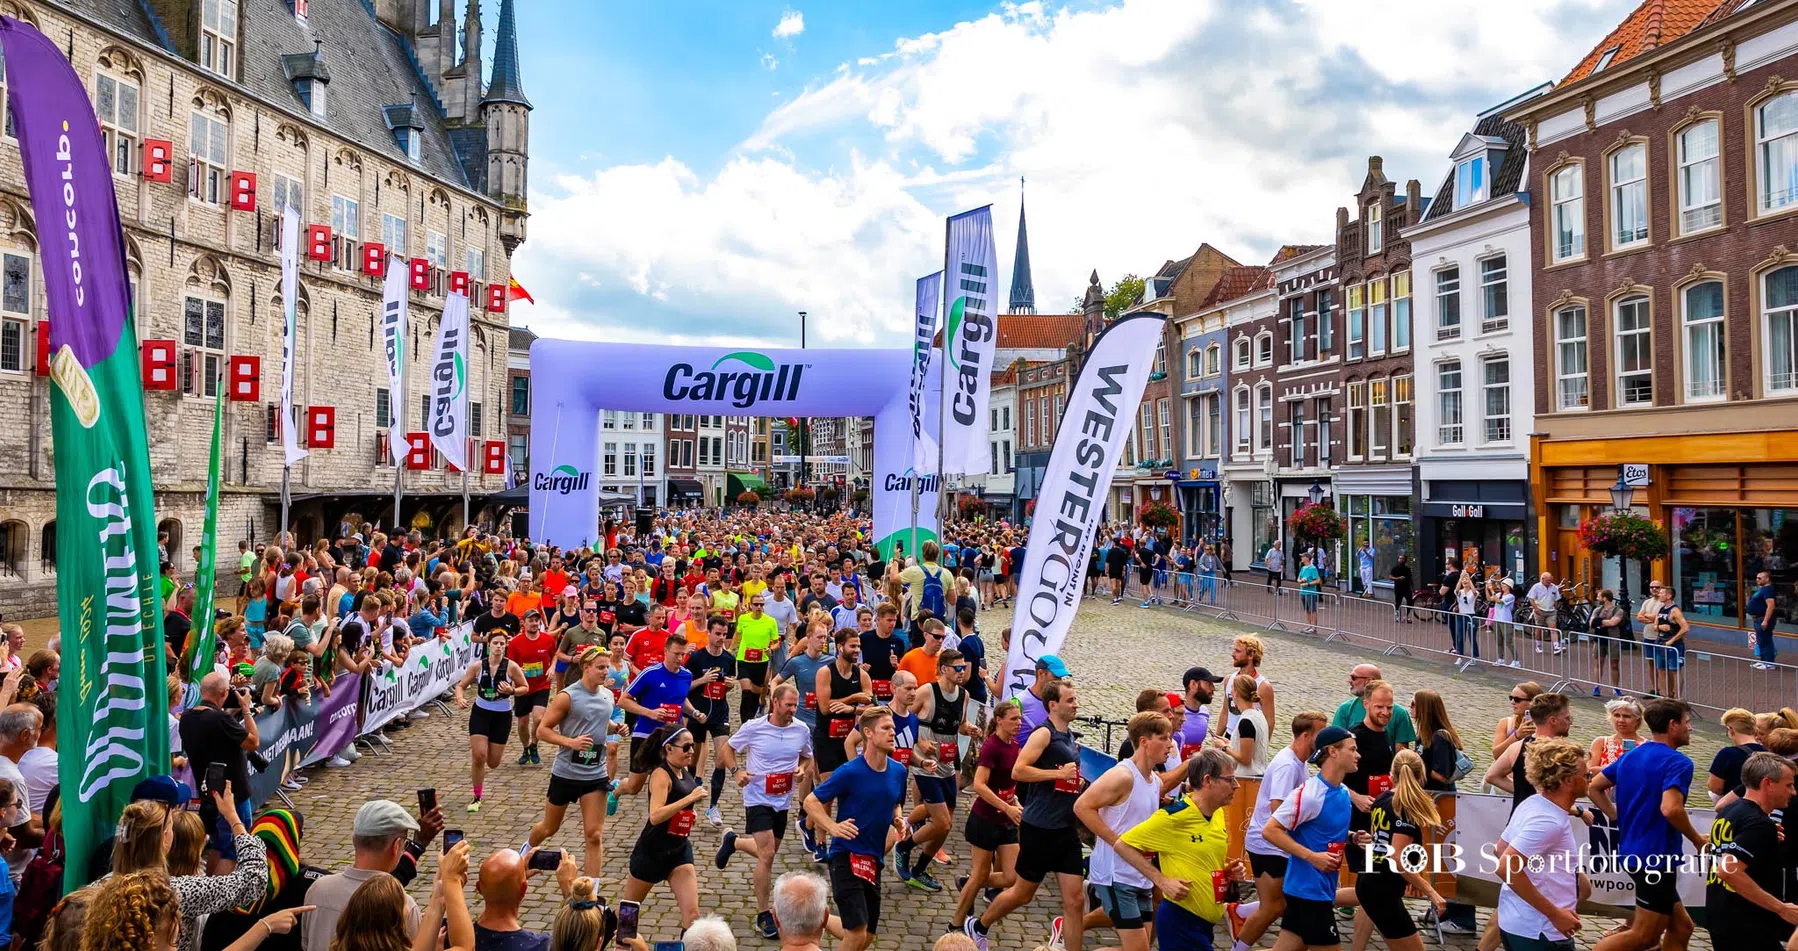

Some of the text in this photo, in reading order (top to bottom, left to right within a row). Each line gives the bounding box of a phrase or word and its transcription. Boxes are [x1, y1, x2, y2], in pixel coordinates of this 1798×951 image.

[953, 262, 994, 427] Cargill
[664, 363, 804, 408] Cargill
[534, 471, 589, 496] Cargill
[1626, 466, 1647, 478] Etos
[1069, 542, 1087, 591] BEGINT
[1063, 591, 1074, 607] IN
[368, 675, 403, 714] Cargill
[407, 662, 433, 697] Cargill
